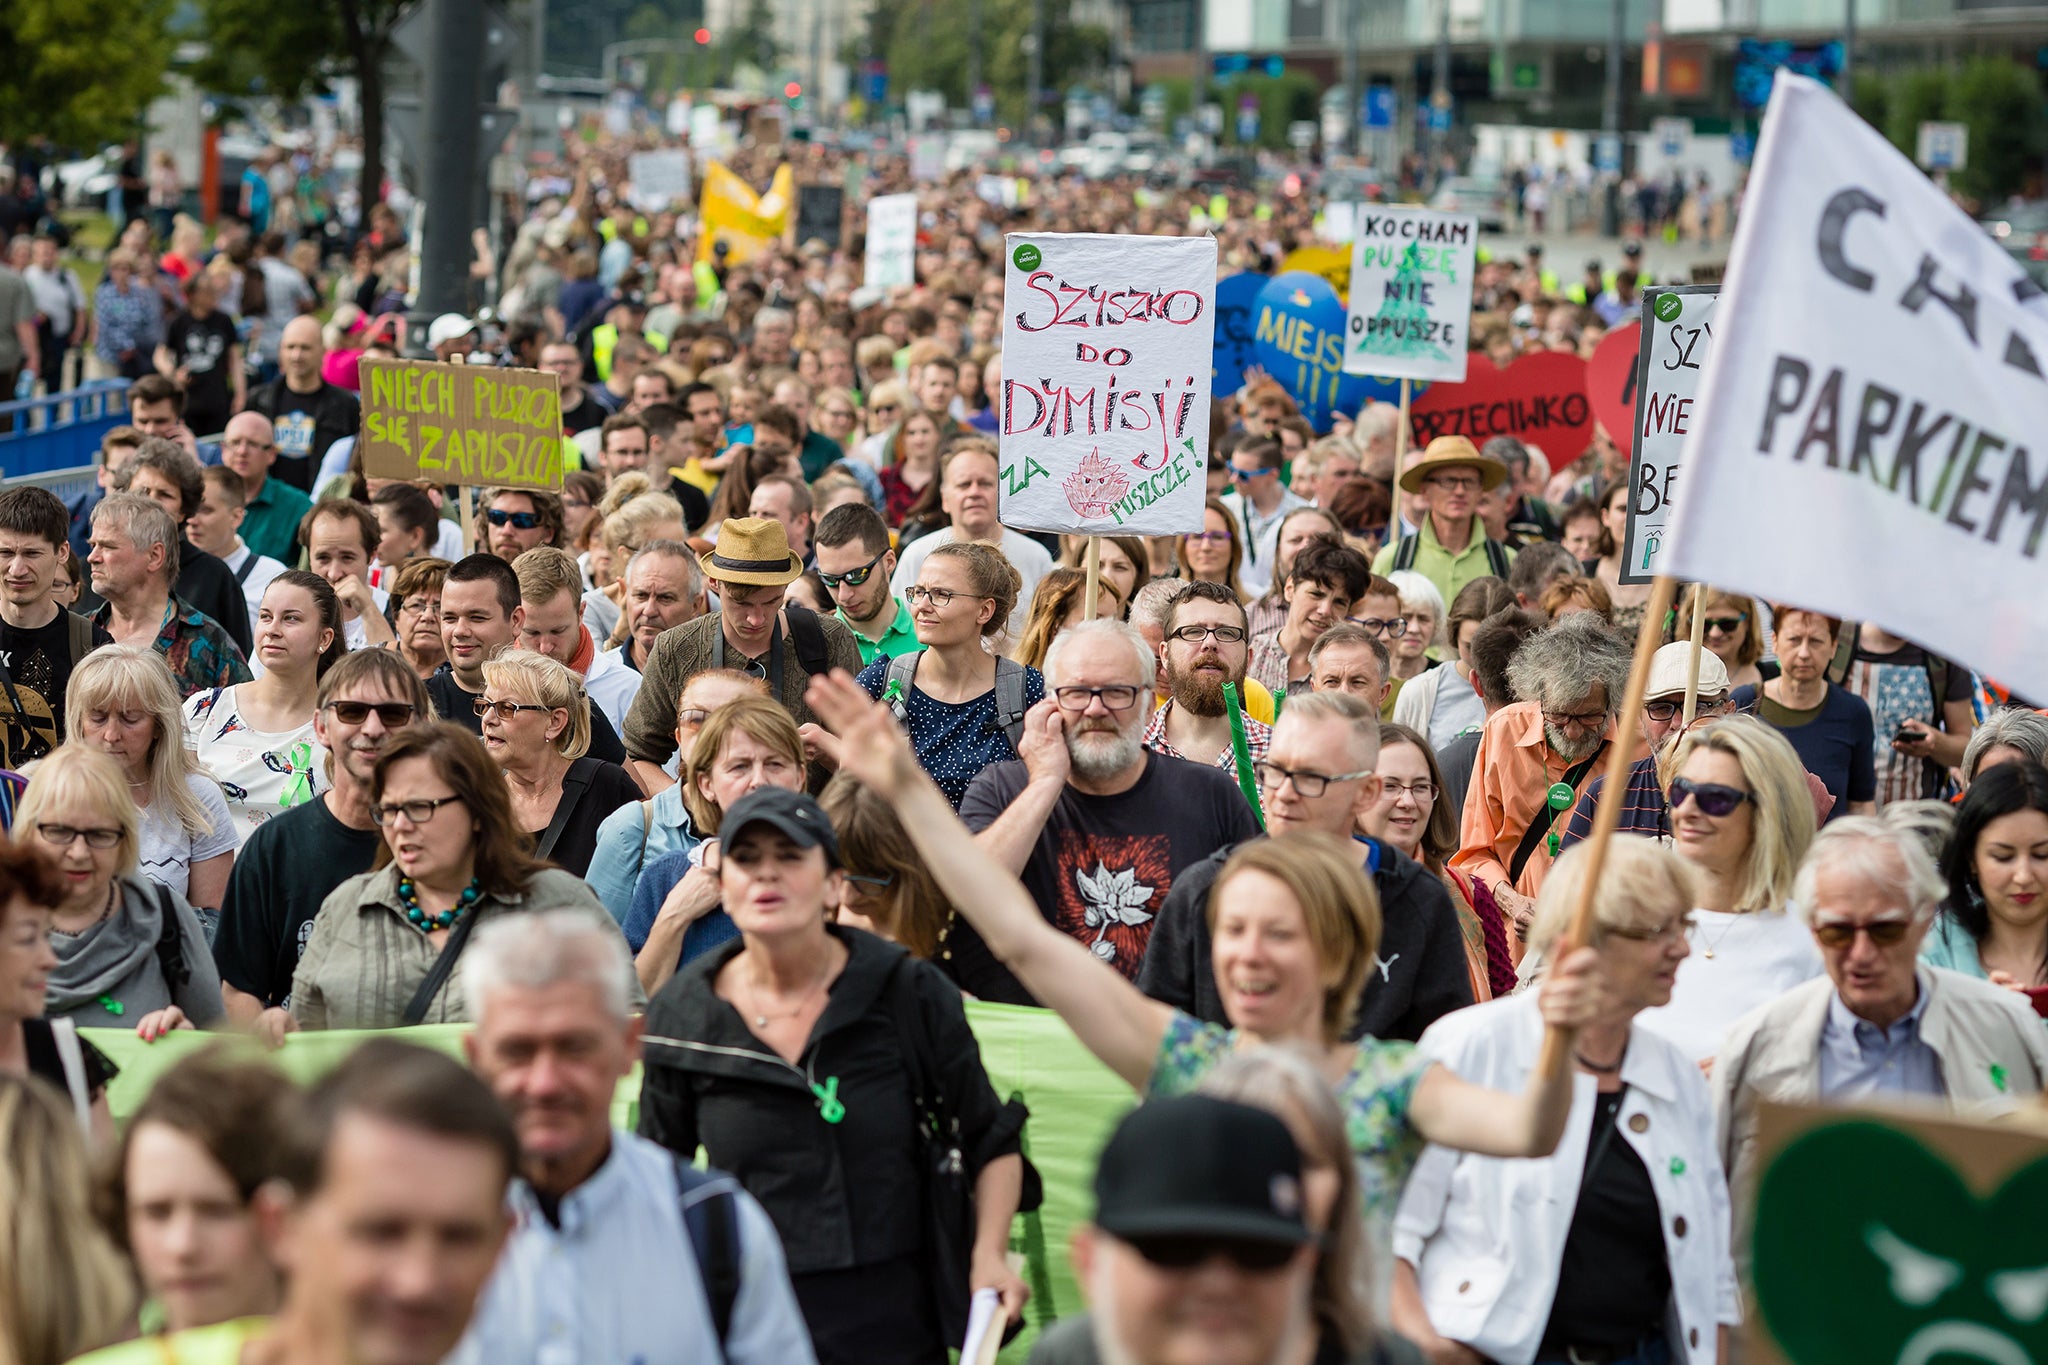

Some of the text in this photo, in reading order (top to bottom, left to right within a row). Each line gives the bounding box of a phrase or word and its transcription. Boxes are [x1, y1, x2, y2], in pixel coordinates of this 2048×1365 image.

[1365, 214, 1469, 244] KOCHAM
[1016, 271, 1203, 332] SZYSZKO
[1384, 281, 1434, 306] NIE
[1076, 342, 1133, 366] DO
[1255, 304, 1344, 374] MIEJS
[1663, 323, 1713, 371] SZ
[371, 365, 455, 420] NIECH
[366, 412, 412, 457] SIĘ
[1410, 392, 1589, 446] PRZECIWKO
[1000, 456, 1050, 497] ZA
[1755, 353, 2048, 561] PARKIEM
